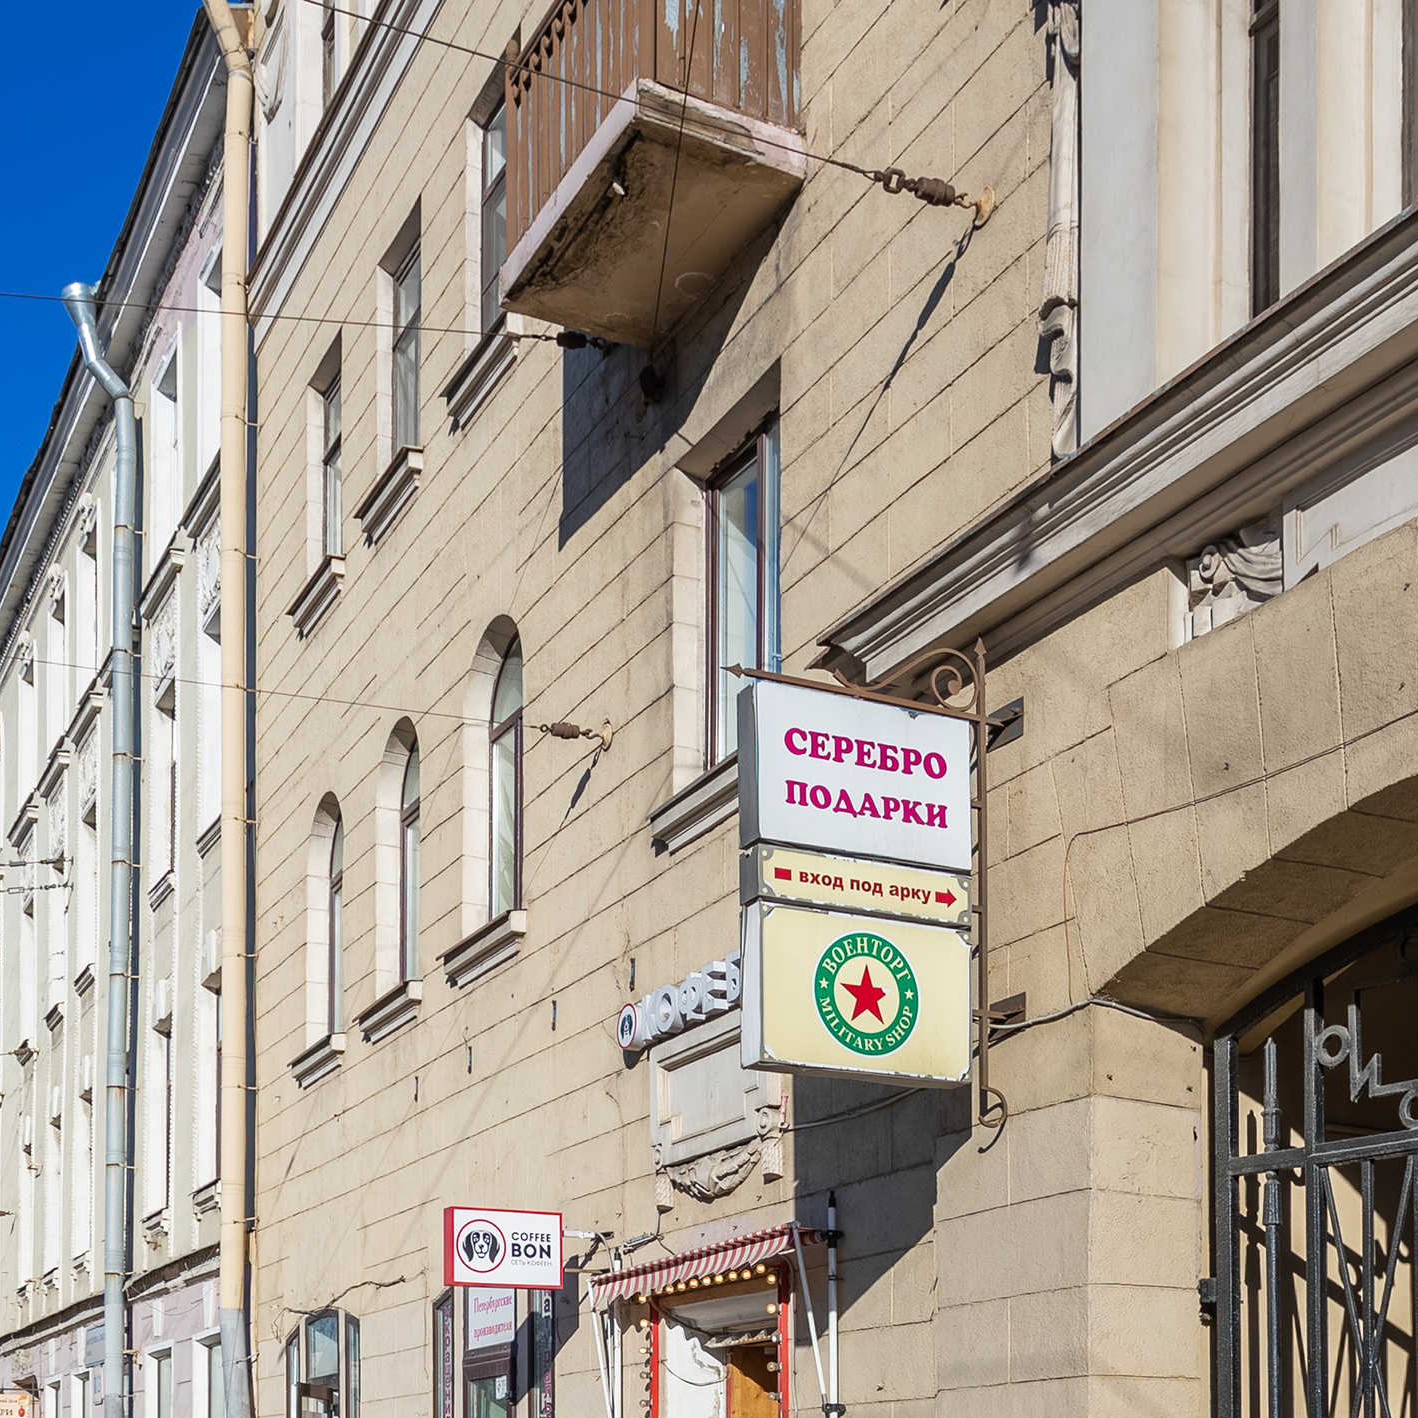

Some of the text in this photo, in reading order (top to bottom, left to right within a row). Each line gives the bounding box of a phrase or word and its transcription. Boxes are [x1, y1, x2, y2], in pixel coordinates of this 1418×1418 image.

[784, 727, 948, 779] СЕРЕБРО
[785, 779, 948, 829] ПОДАРКИ
[799, 871, 932, 905] вход под арку
[821, 936, 912, 981] ВОЕНТОРГ
[819, 997, 914, 1051] MILITARY SHOP
[511, 1231, 551, 1243] COFFEE
[511, 1243, 551, 1259] BON
[473, 1295, 513, 1315] Петербургские
[473, 1321, 513, 1341] производители
